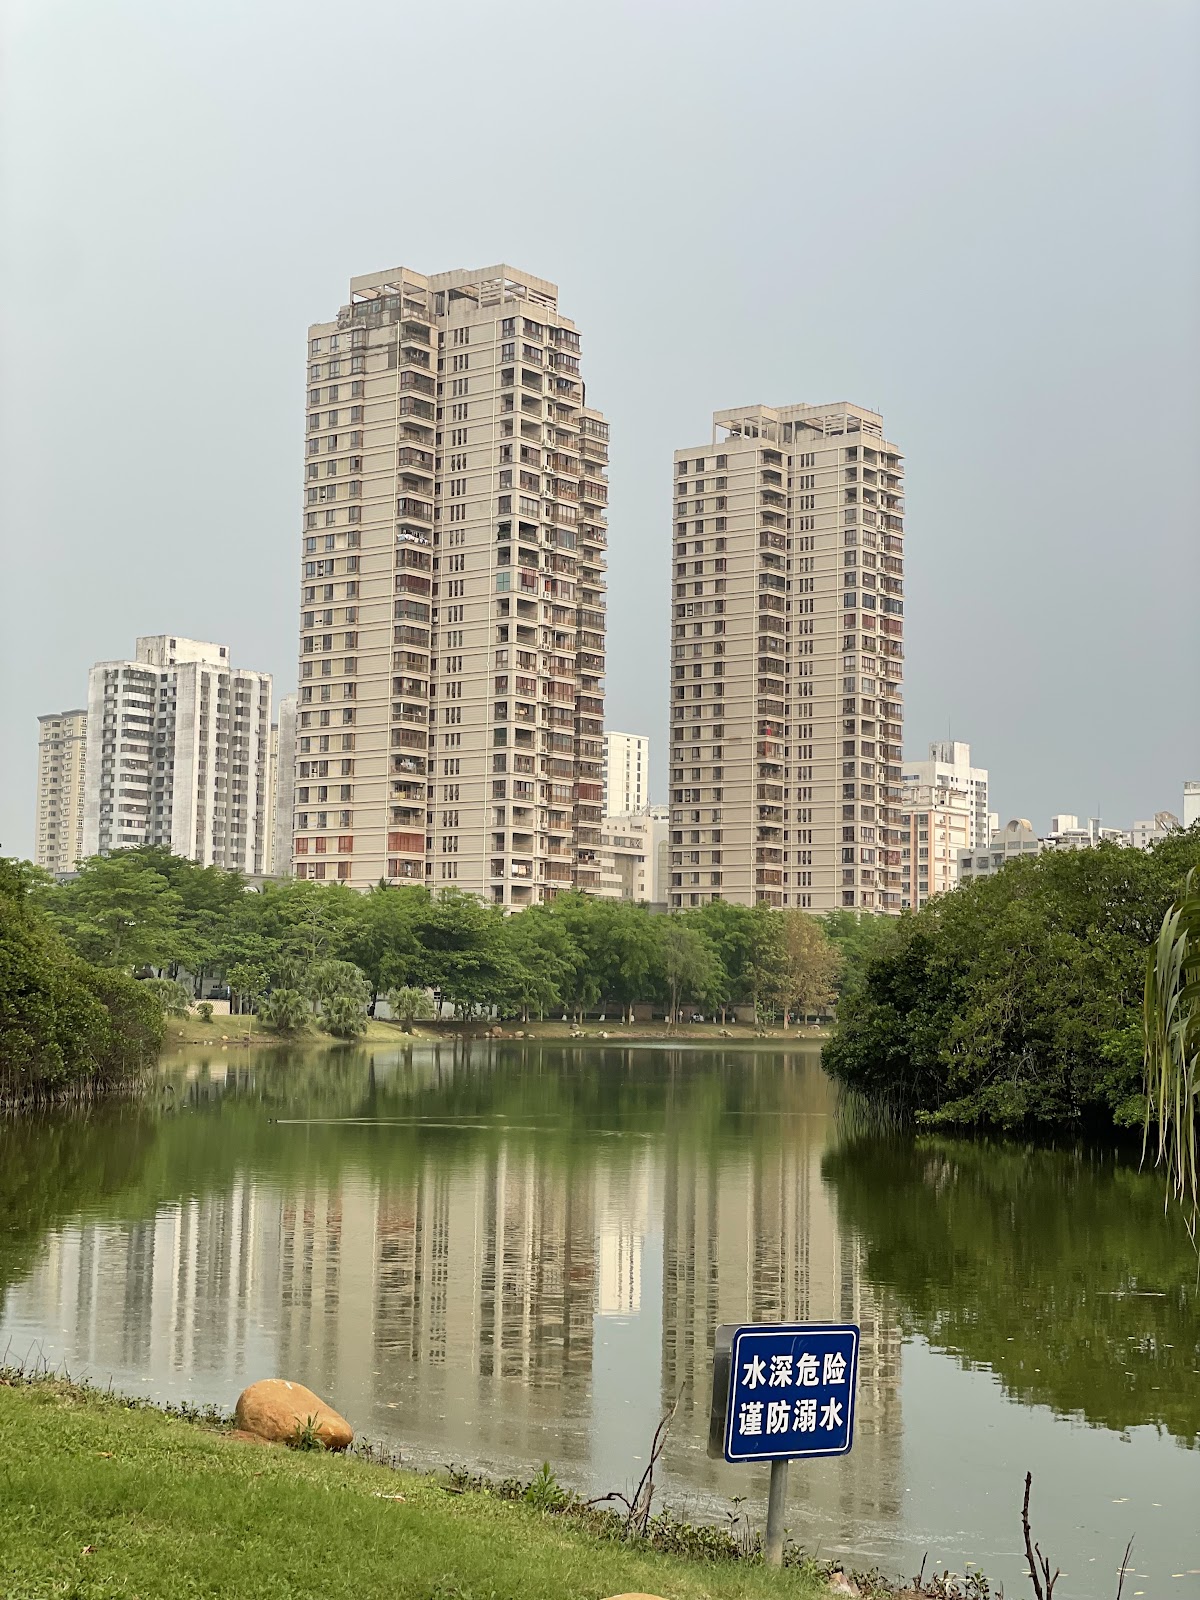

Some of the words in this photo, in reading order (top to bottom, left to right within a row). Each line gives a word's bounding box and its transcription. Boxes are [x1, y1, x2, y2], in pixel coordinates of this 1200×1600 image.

[741, 1352, 848, 1390] 水深危险
[738, 1397, 844, 1436] 谨防溺水
